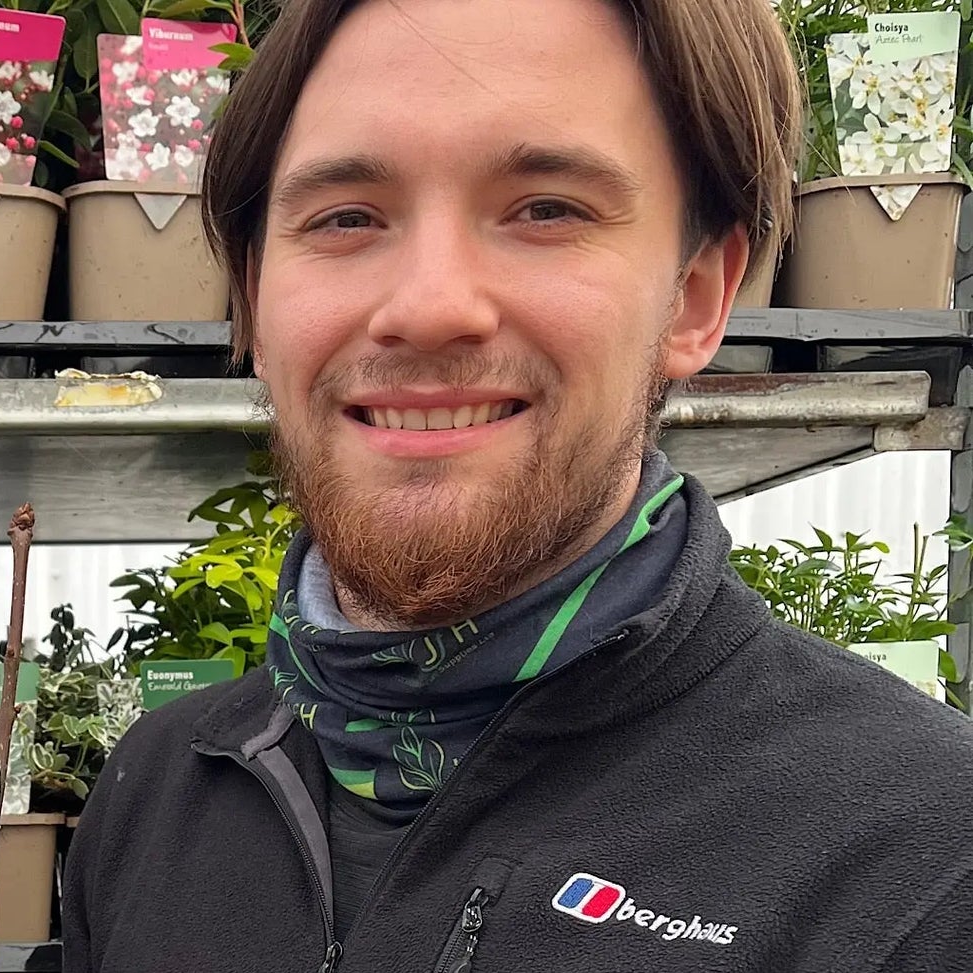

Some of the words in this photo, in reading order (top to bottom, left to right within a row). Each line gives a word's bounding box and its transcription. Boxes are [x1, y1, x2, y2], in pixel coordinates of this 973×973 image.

[149, 28, 194, 41] Viburnum
[874, 23, 909, 34] Choisya
[864, 651, 887, 662] oisya
[147, 669, 194, 682] Euonymus
[615, 897, 739, 945] berghaus
